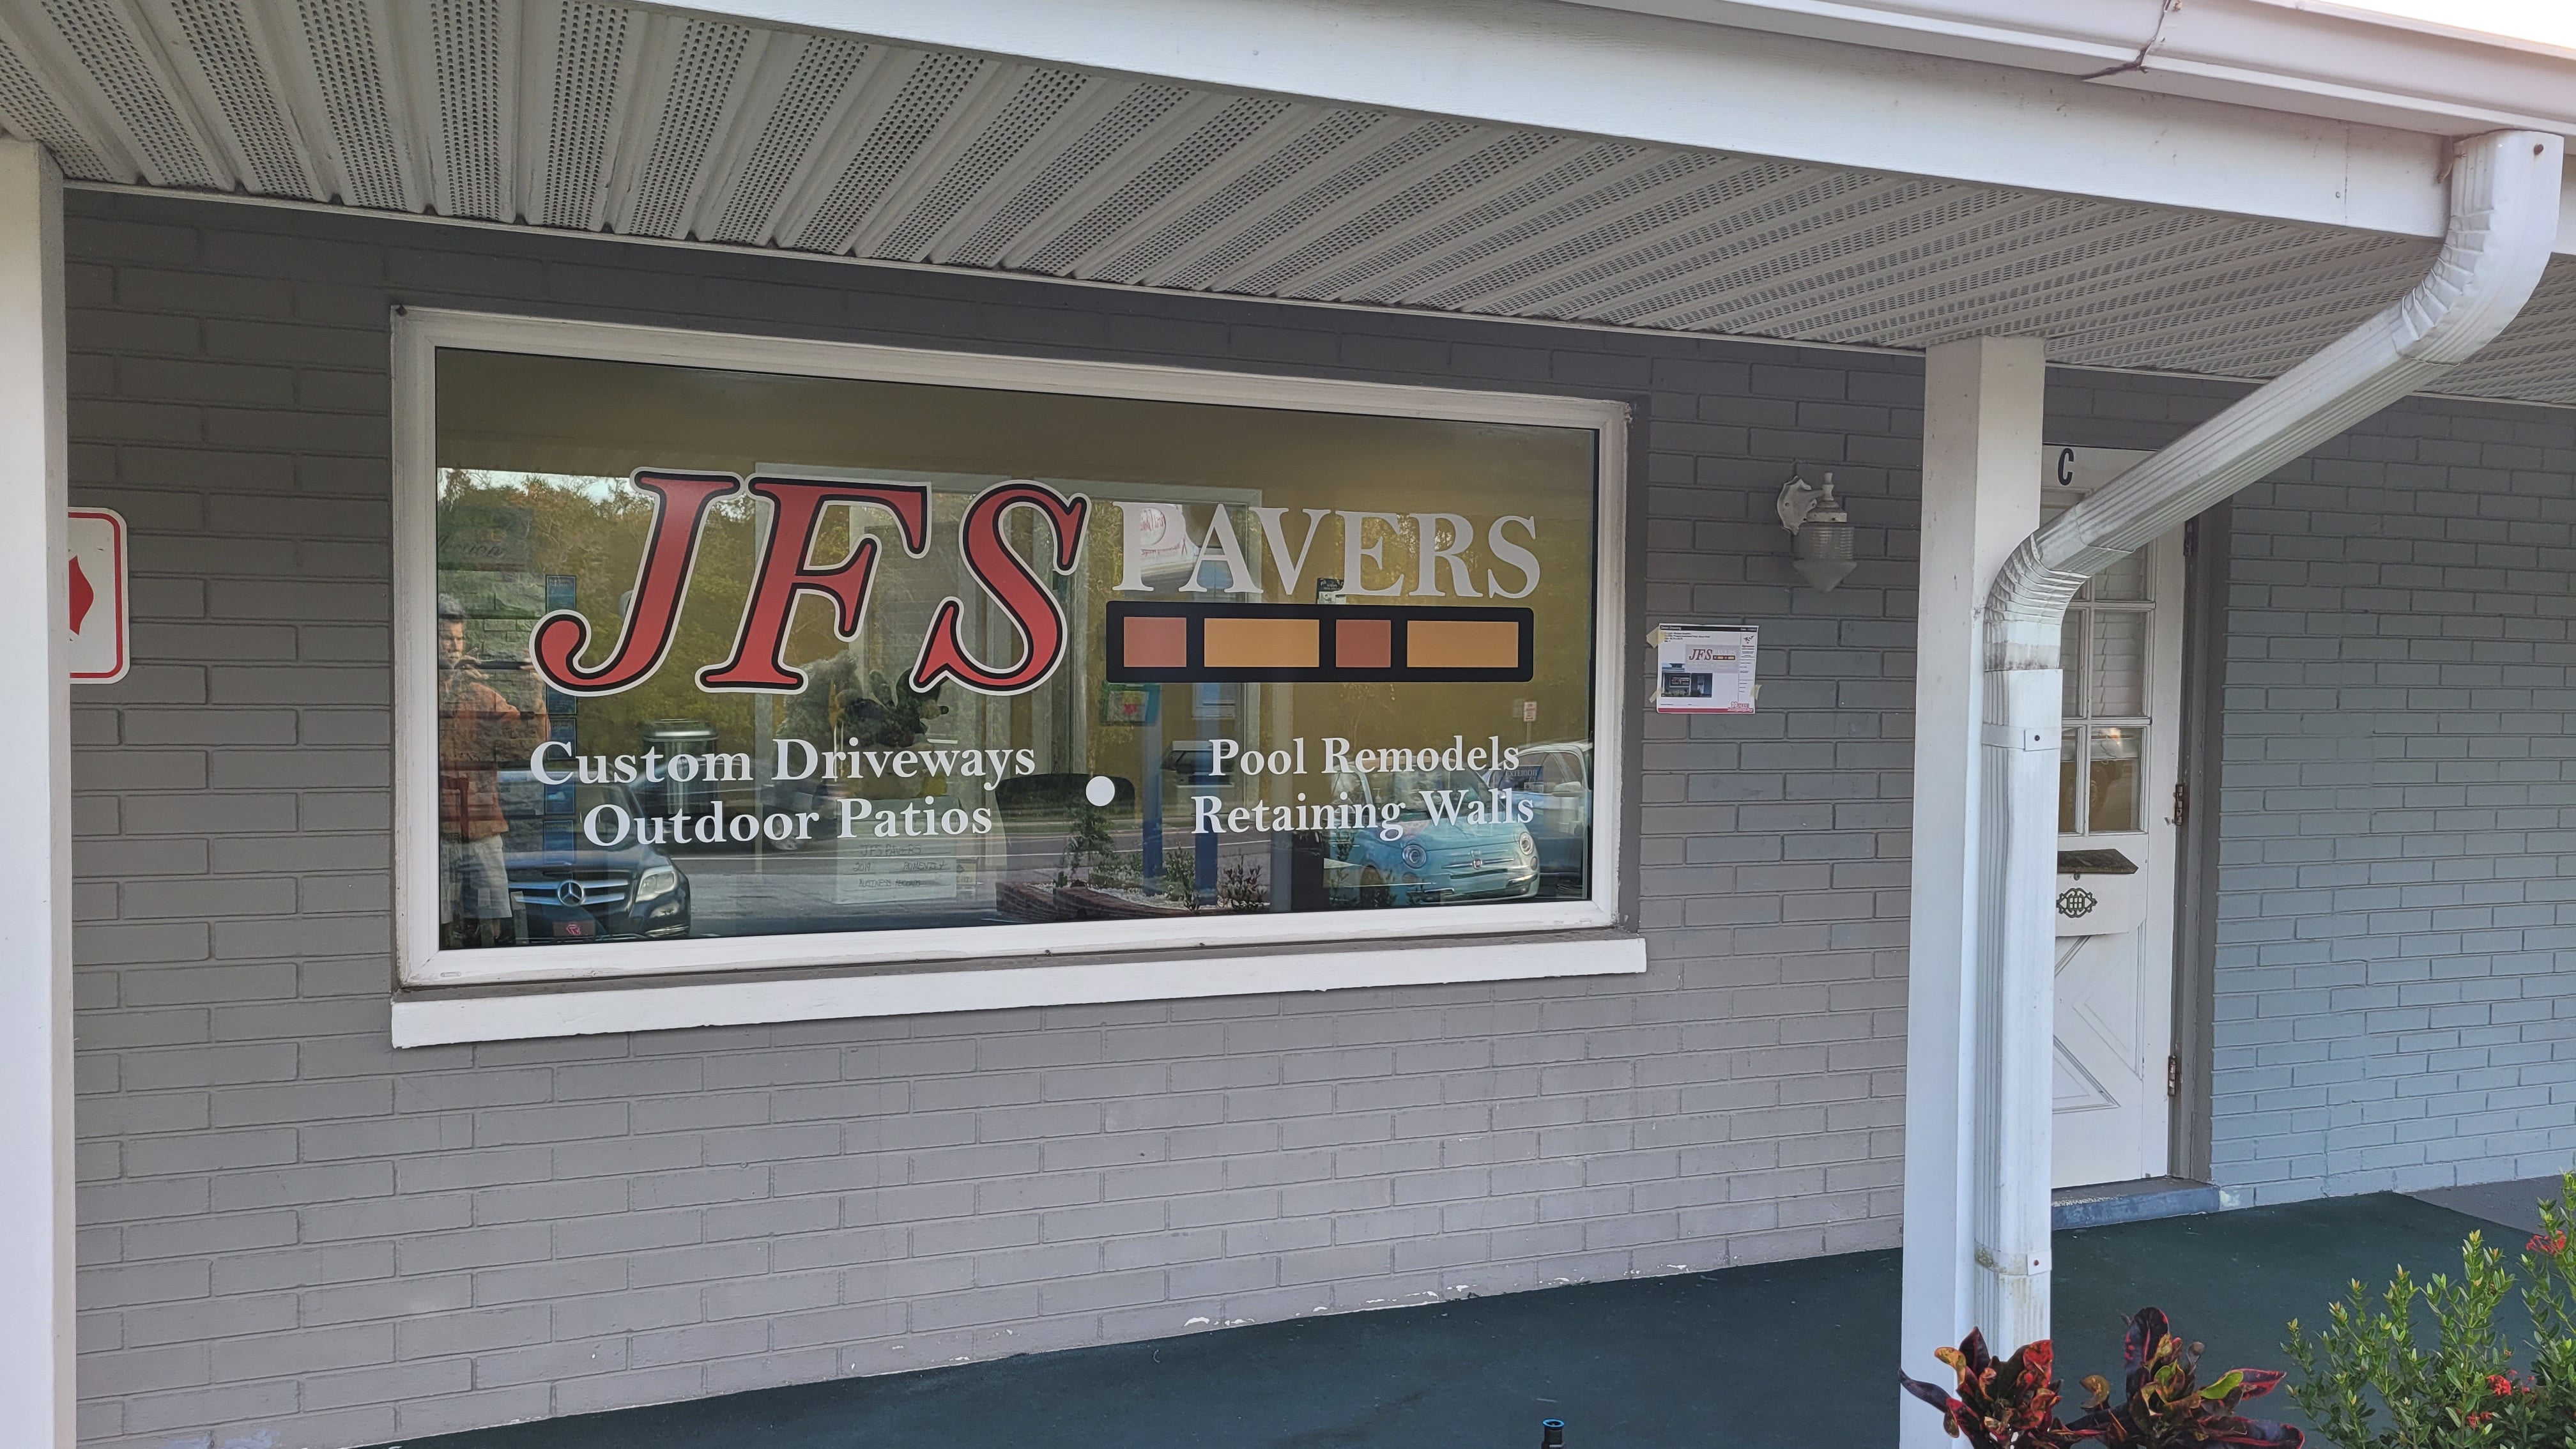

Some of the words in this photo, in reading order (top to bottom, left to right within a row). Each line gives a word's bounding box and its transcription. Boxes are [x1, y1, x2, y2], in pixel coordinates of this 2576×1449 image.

[2058, 447, 2074, 486] C
[1112, 501, 1541, 599] PAVERS
[529, 466, 1091, 696] JFS
[1689, 648, 1713, 661] JFS
[530, 740, 751, 785] Custom
[772, 737, 1036, 791] Driveways
[1208, 737, 1307, 777] Pool
[1321, 735, 1520, 774] Remodels
[583, 801, 820, 847] Outdoor
[836, 795, 992, 839] Patios
[1191, 792, 1406, 841] Retaining
[1418, 787, 1534, 827] Walls
